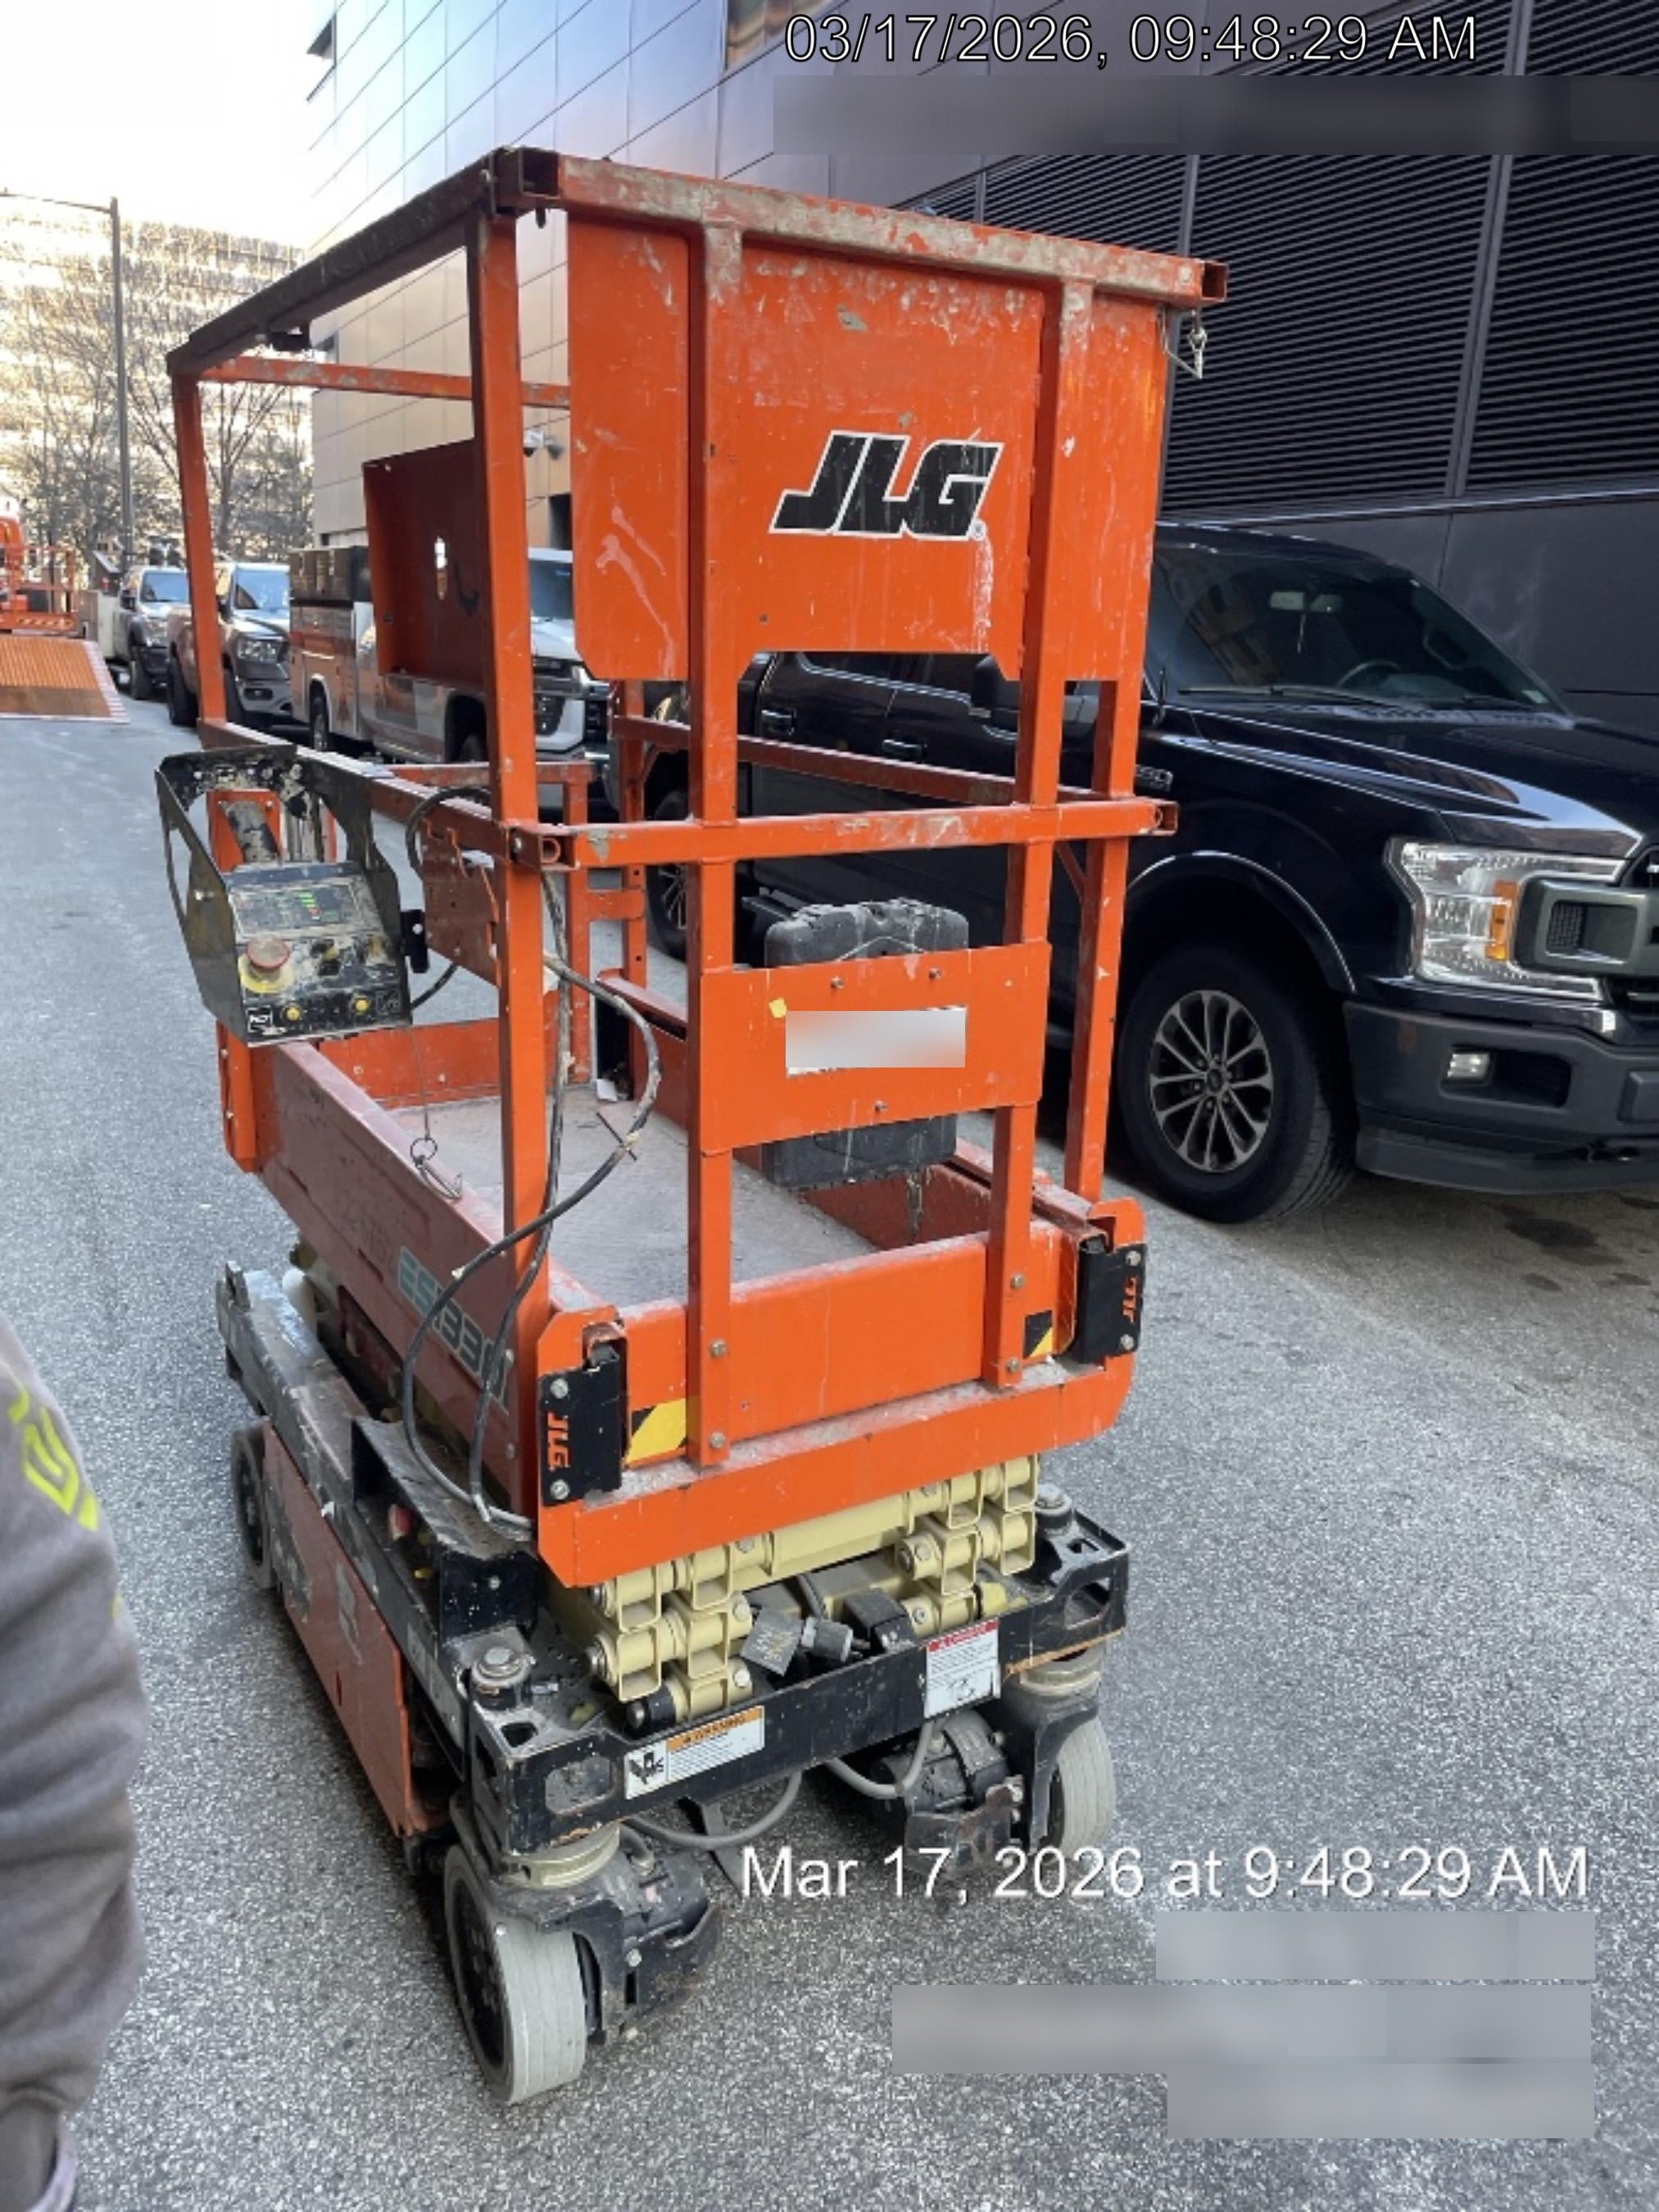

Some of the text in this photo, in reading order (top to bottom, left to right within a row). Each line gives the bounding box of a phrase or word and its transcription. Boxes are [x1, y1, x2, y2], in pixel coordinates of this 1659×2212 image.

[769, 429, 1005, 541] JLG
[1122, 1276, 1137, 1323] JLG
[546, 1412, 571, 1472] JLG
